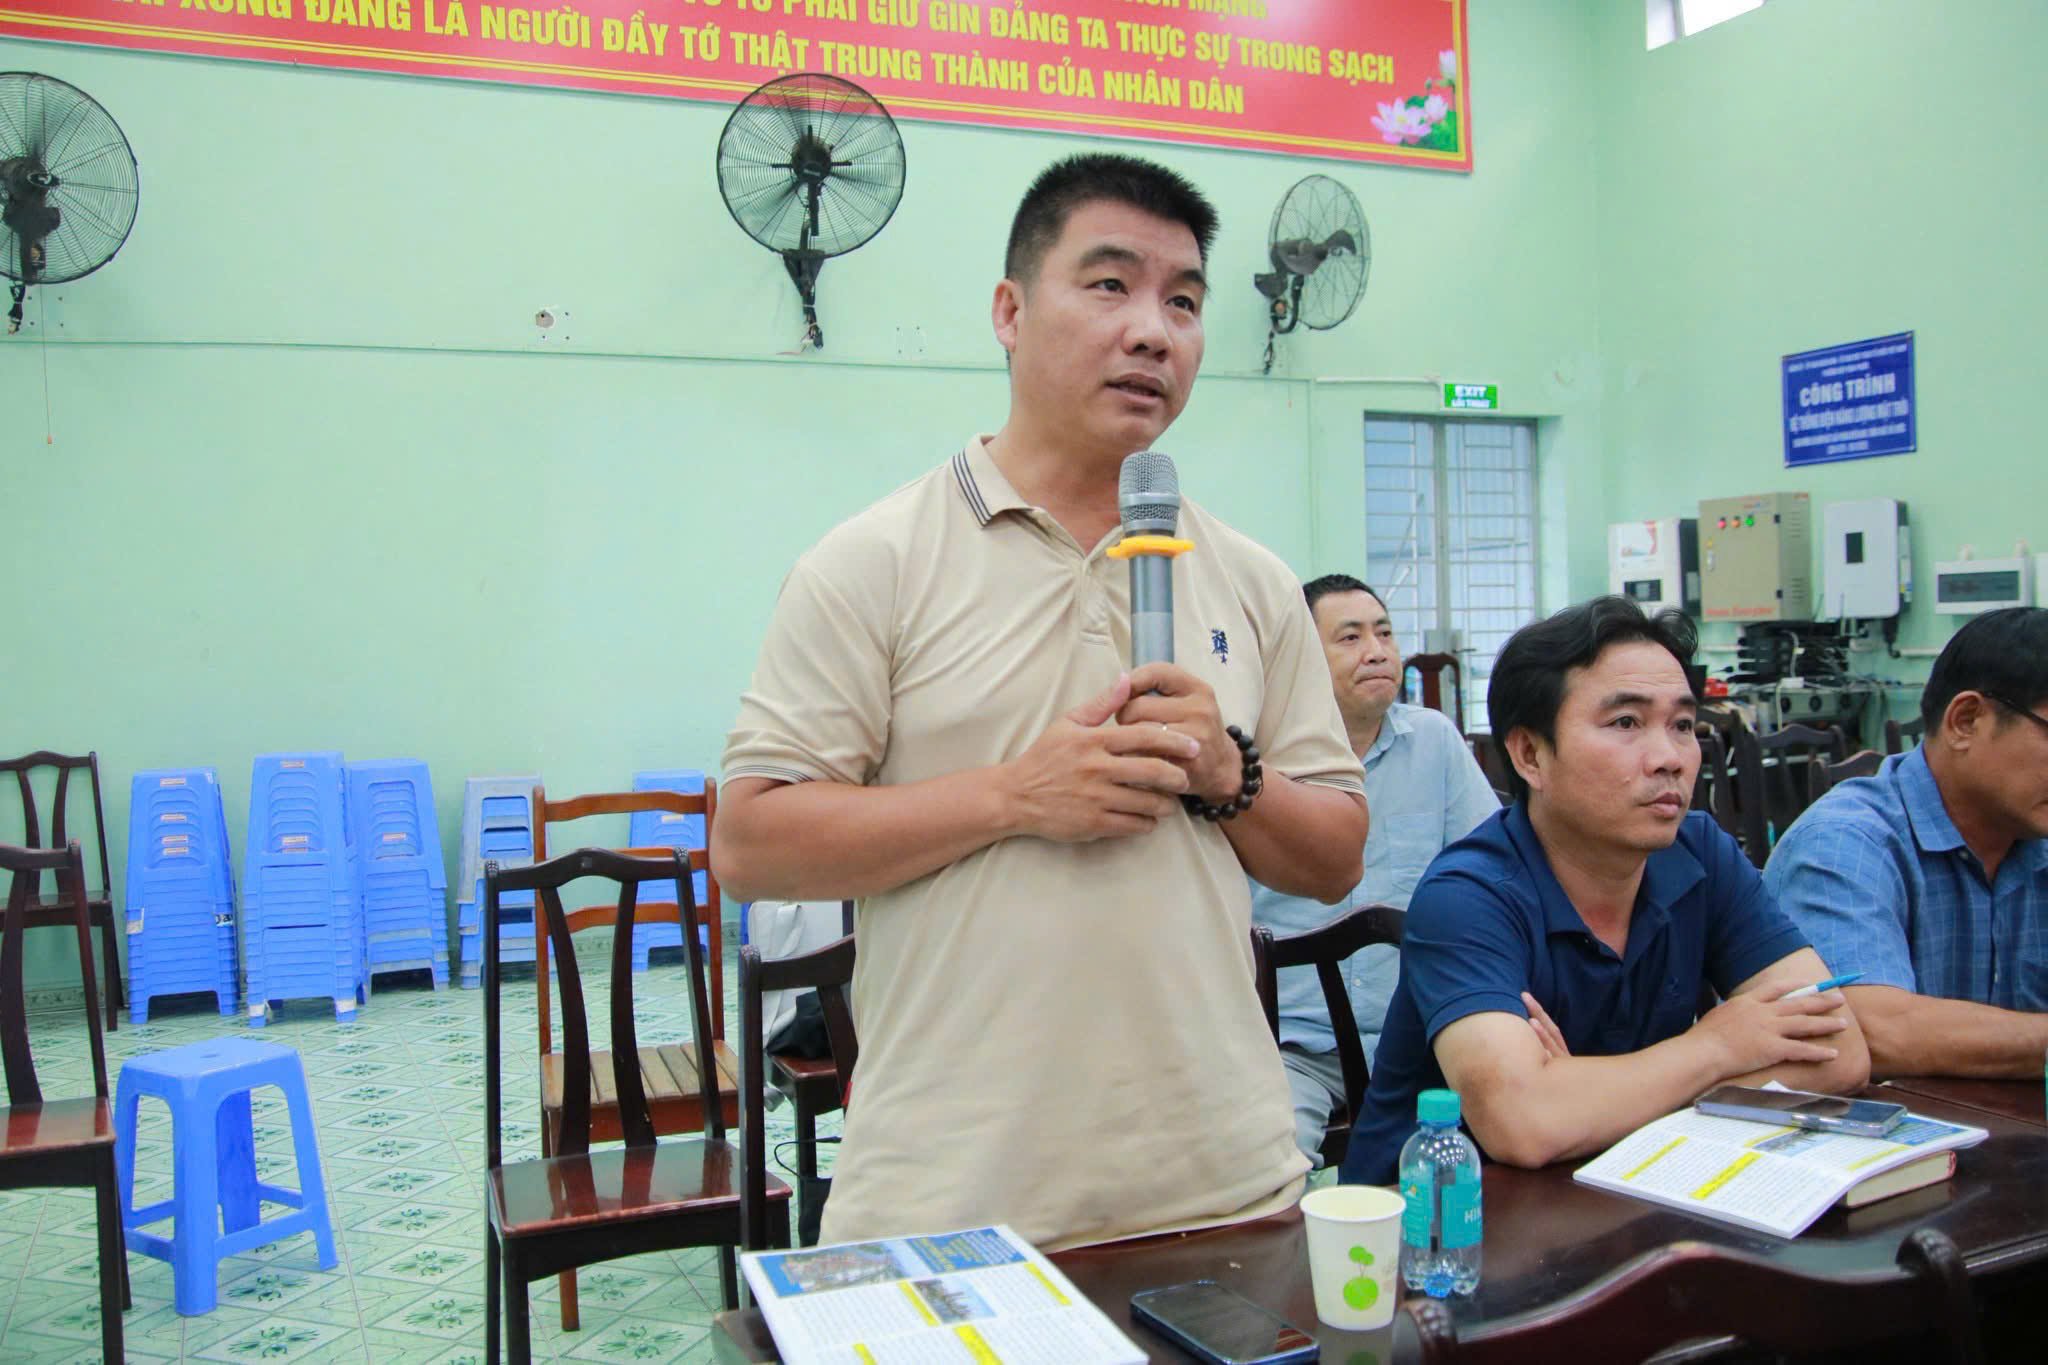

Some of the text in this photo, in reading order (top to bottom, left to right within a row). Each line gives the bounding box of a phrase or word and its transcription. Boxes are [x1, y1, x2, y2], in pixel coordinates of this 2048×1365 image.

[480, 4, 591, 48] NGƯỜI
[602, 10, 669, 56] ĐẦY
[680, 22, 721, 62] TỚ
[730, 29, 809, 76] THẬT
[818, 40, 922, 81] TRUNG
[931, 51, 1029, 92] THÀNH
[1038, 56, 1096, 99] CỦA
[1103, 68, 1182, 108] NHÂN
[1189, 76, 1244, 114] DÂN
[989, 1, 1069, 45] ĐẢNG
[1077, 17, 1109, 49] TA
[1116, 21, 1186, 62] THỰC
[1195, 31, 1232, 70] SỰ
[1236, 37, 1321, 75] TRONG
[1328, 48, 1395, 86] SẠCH
[1799, 373, 1896, 407] CÔNG TRÌNH
